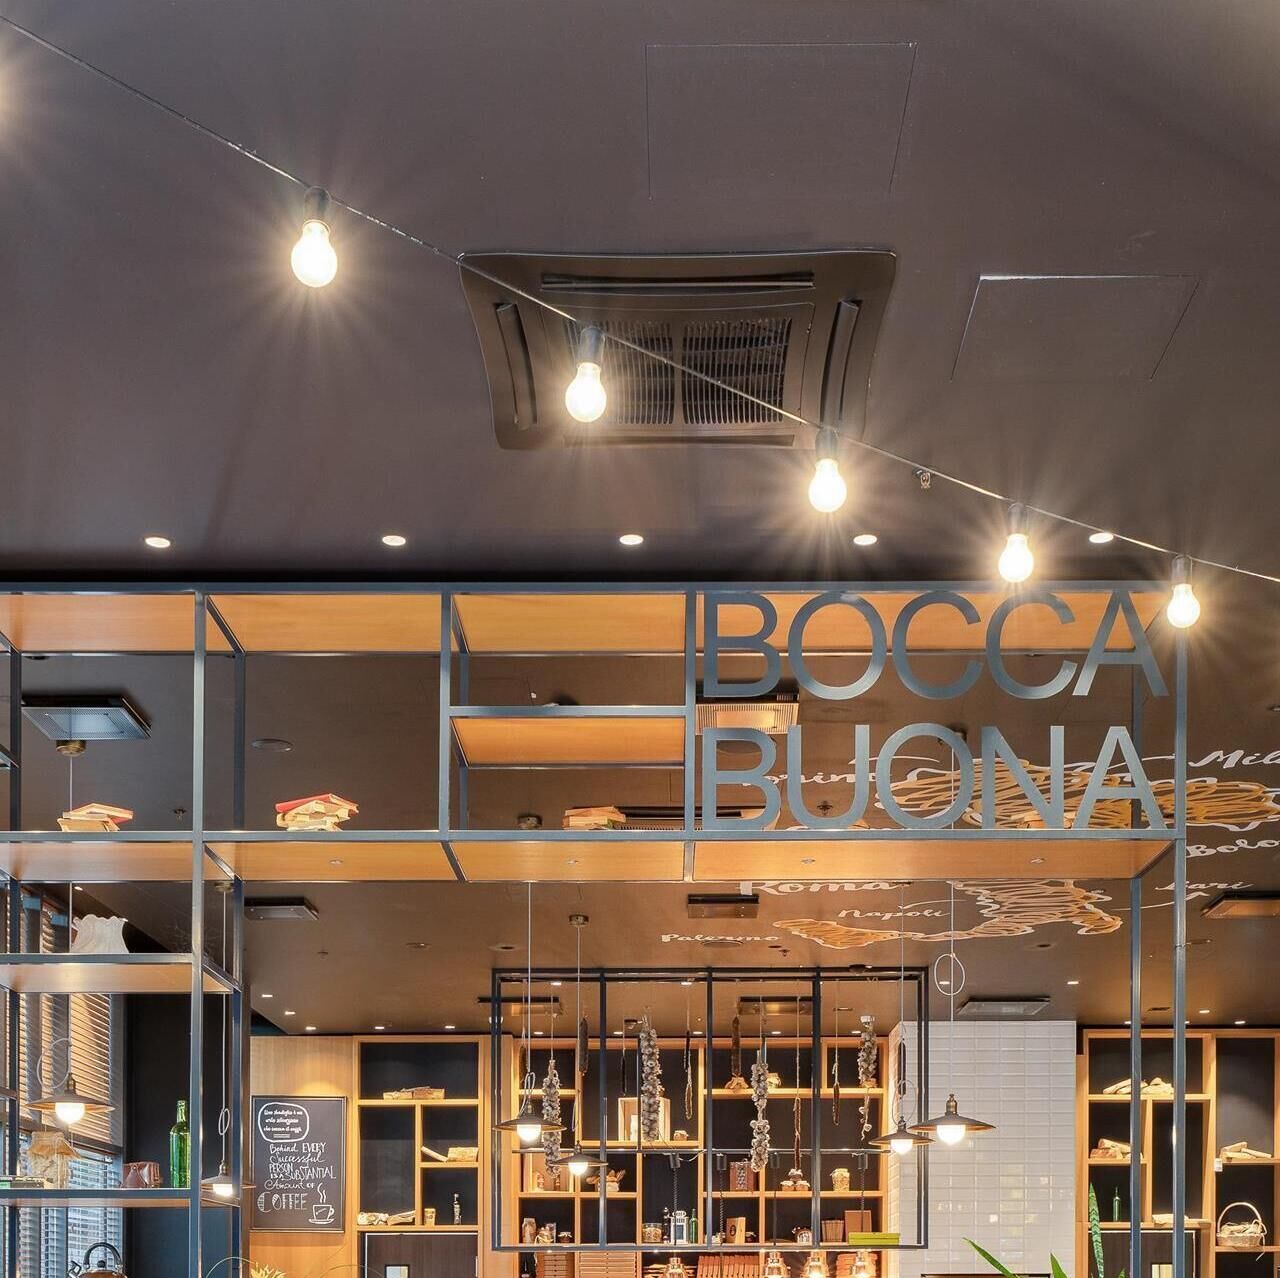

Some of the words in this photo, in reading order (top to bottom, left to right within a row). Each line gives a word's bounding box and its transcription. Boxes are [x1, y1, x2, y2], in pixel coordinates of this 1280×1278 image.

[703, 590, 1169, 699] BOCCA
[702, 722, 1168, 830] BUONA
[739, 881, 910, 895] Roma
[838, 907, 951, 921] Napoli
[661, 933, 780, 942] Palermo
[269, 1143, 298, 1154] Behind
[269, 1150, 325, 1167] Successful
[269, 1163, 293, 1173] PERSON
[281, 1165, 336, 1181] SUBSTANTIAL
[264, 1179, 306, 1190] Amount
[257, 1191, 308, 1213] COFFEE
